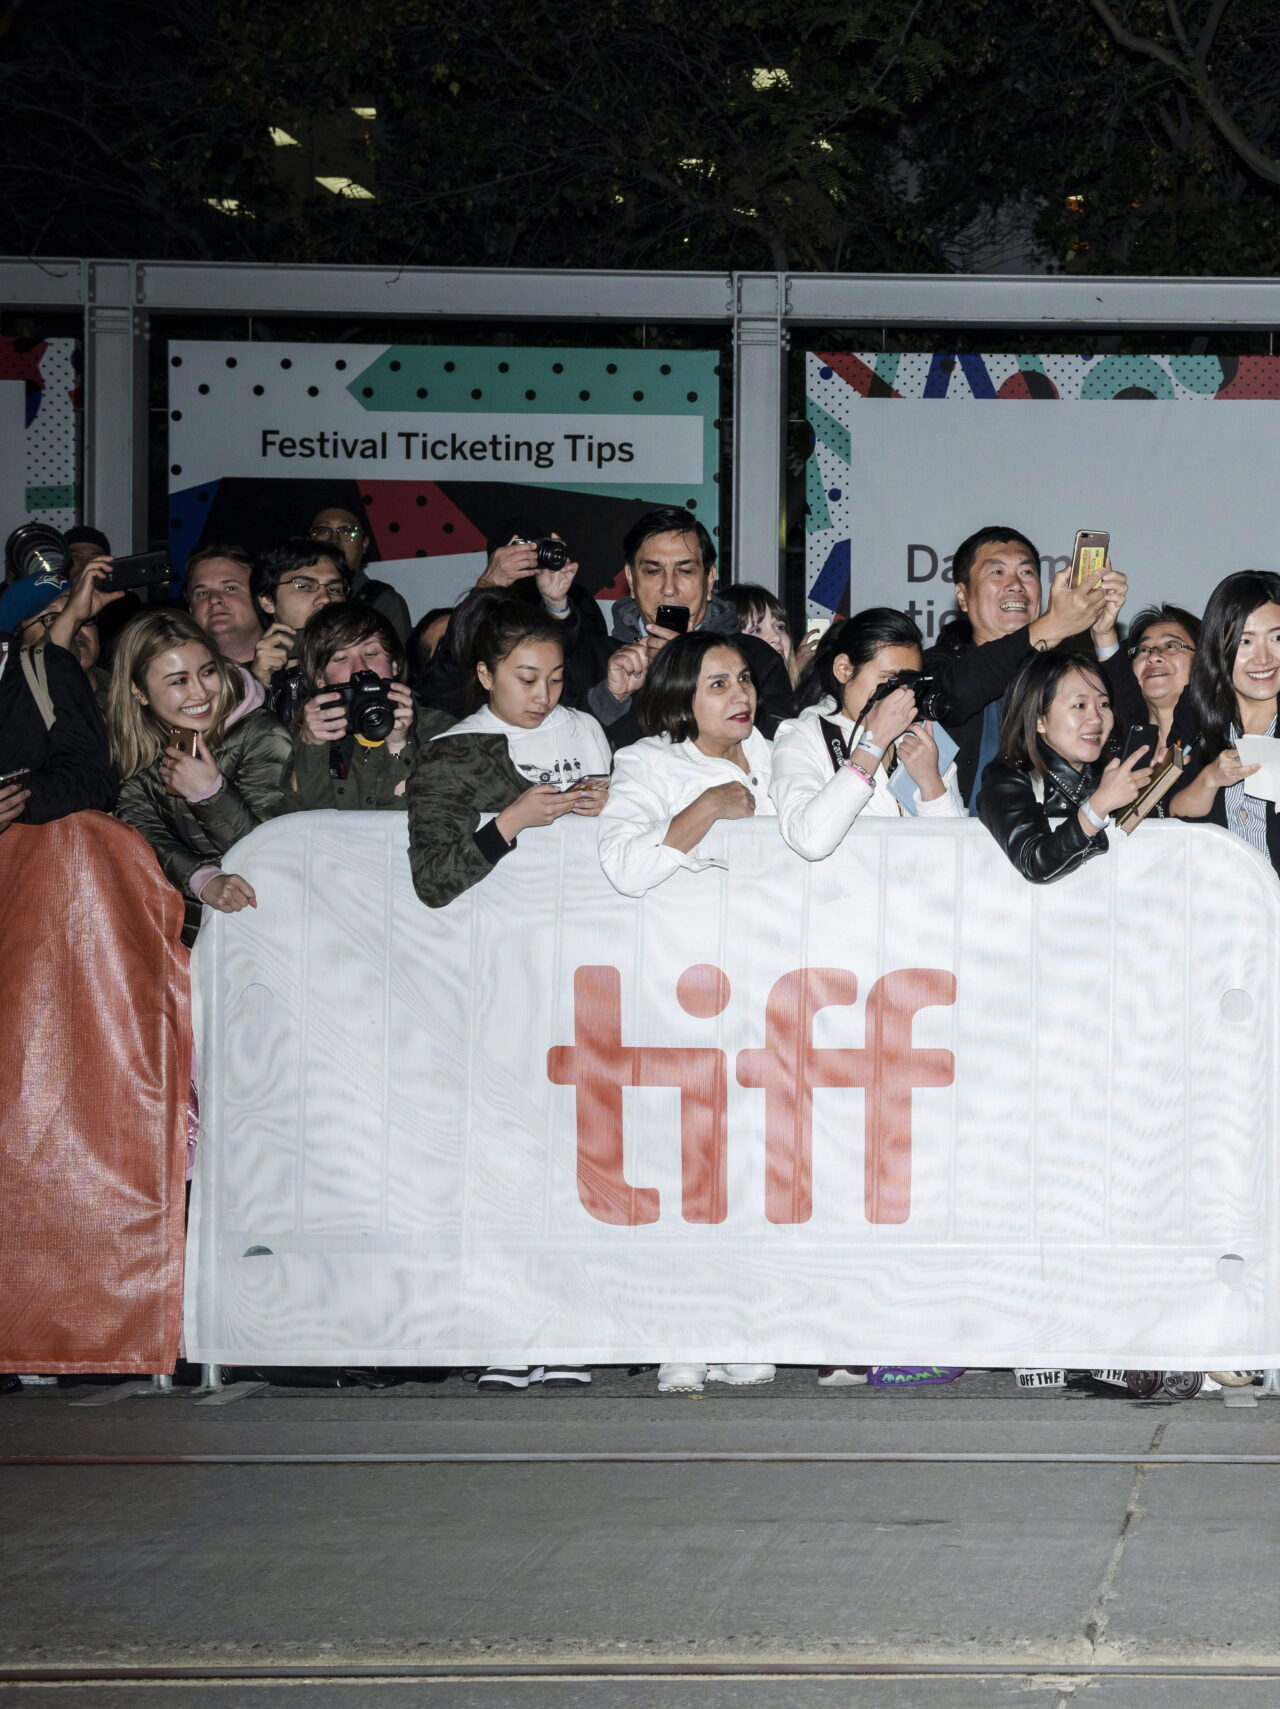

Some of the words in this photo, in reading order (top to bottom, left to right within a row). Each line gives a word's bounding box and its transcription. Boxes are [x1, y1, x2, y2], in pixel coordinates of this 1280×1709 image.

[261, 429, 387, 459] Festival
[398, 431, 555, 468] Ticketing
[564, 433, 635, 469] Tips
[547, 963, 958, 1226] tiff
[1019, 1373, 1034, 1386] OFF
[1036, 1371, 1061, 1385] THE
